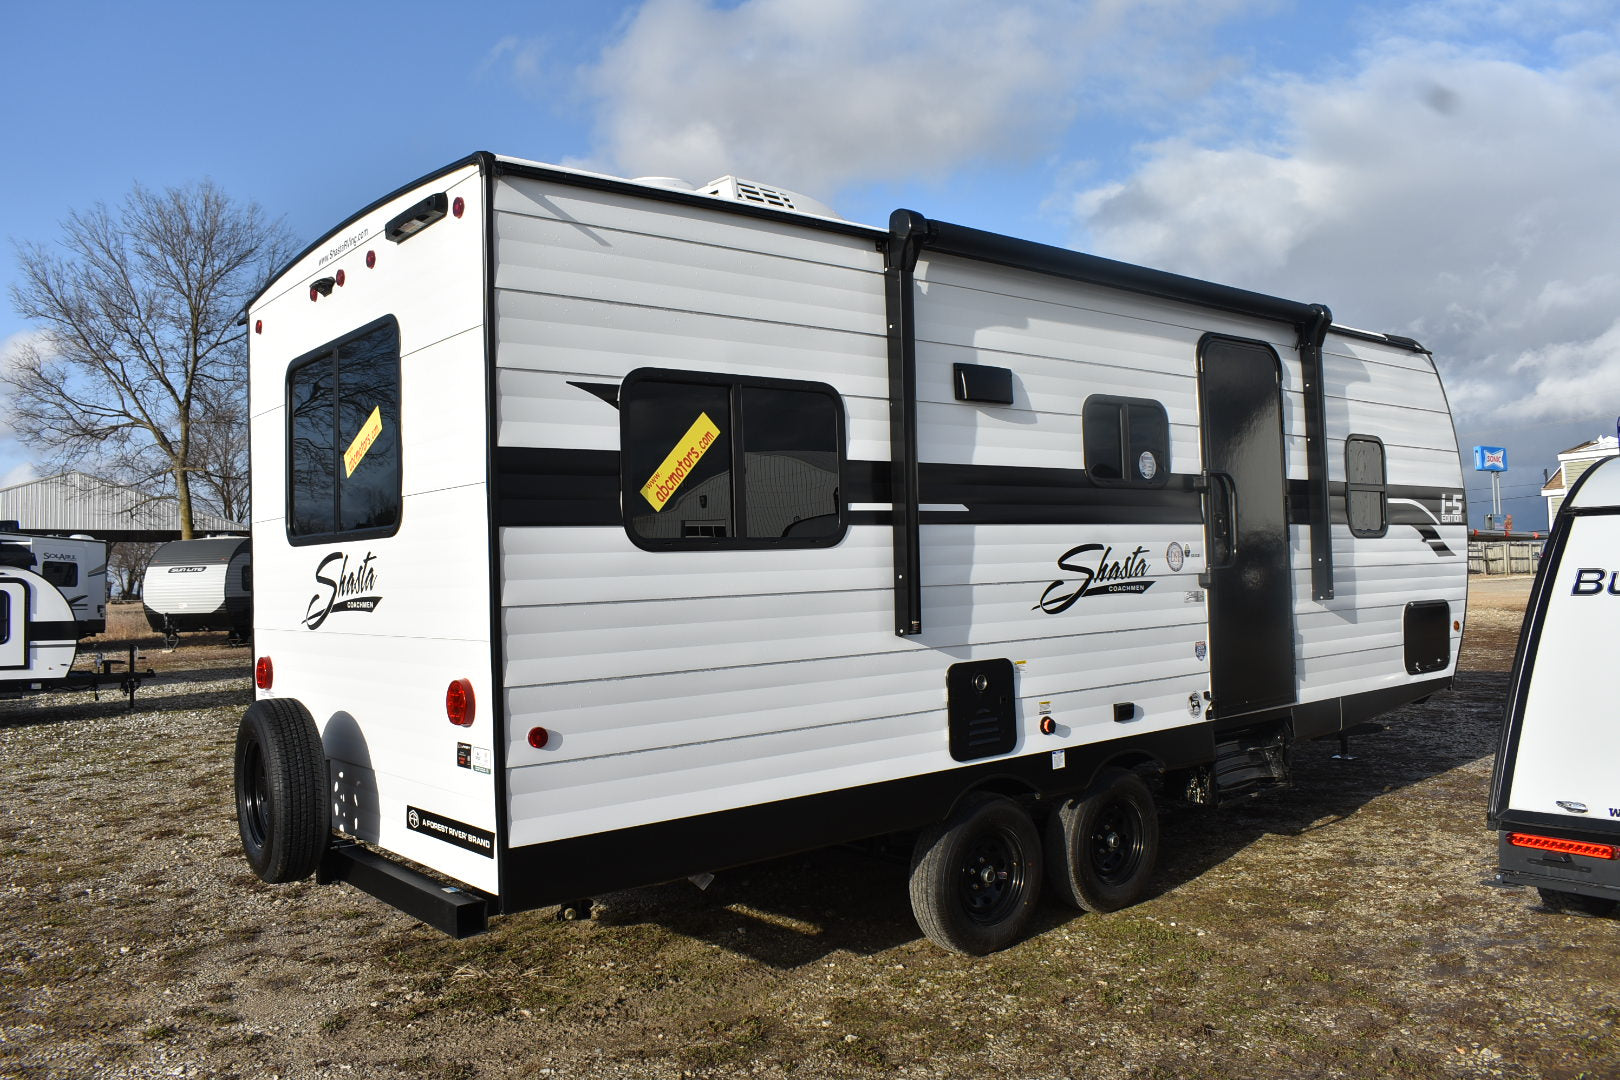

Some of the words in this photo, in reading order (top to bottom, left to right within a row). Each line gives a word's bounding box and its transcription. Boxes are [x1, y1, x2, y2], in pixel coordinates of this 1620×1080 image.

[655, 431, 715, 503] abcmotors.com
[1487, 455, 1502, 463] SONIC
[1441, 514, 1463, 523] EDITION
[1040, 543, 1151, 615] Shasta
[1108, 584, 1145, 592] COACHMEN
[305, 551, 378, 631] Shasta
[346, 601, 374, 609] COACHMEN
[422, 818, 427, 827] A
[426, 819, 449, 834] FOREST
[467, 833, 491, 849] BRAND
